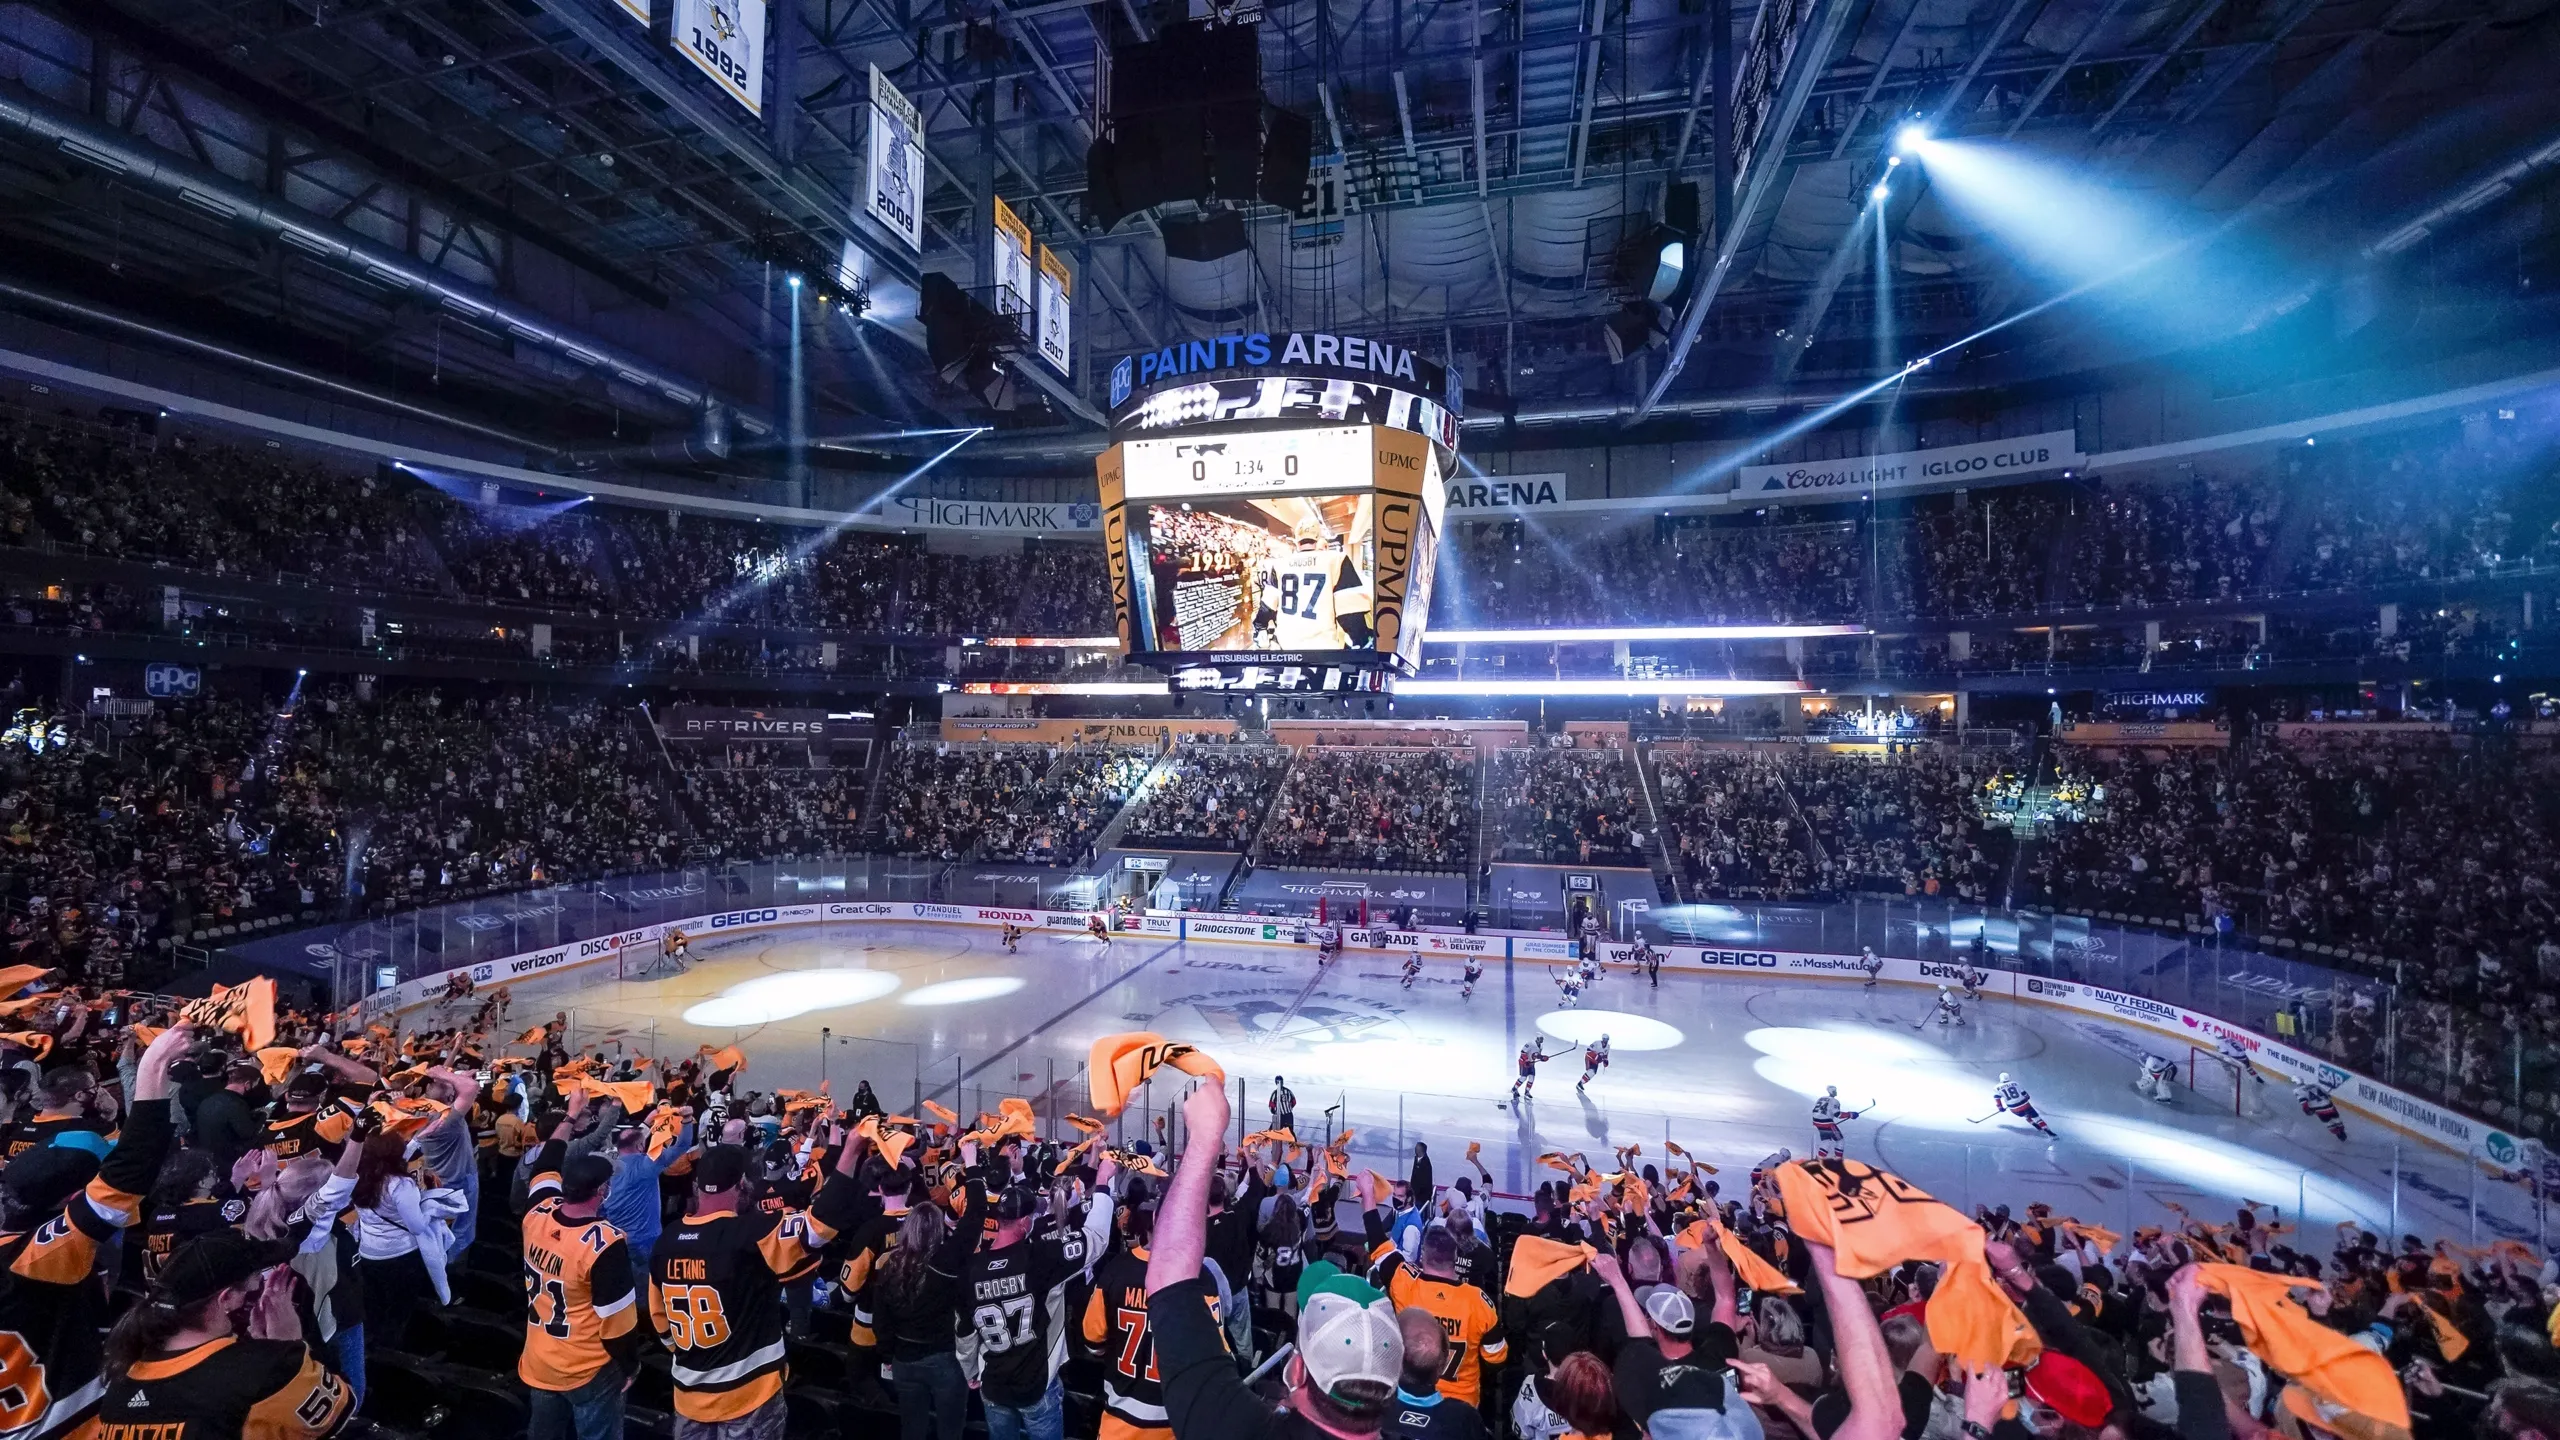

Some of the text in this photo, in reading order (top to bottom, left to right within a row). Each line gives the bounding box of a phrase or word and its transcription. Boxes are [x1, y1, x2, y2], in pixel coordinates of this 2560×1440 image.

[1237, 12, 1261, 25] 2006
[692, 27, 747, 91] 1992
[876, 190, 914, 235] 2009
[1044, 336, 1064, 362] 2017
[1140, 332, 1272, 385] PAINTS
[1280, 333, 1417, 382] ARENA
[1192, 455, 1298, 481] 0 1:34 0
[1378, 450, 1420, 471] UPMC
[1787, 448, 2050, 489] Coors LIGHT IGLOO CLUB
[1100, 466, 1121, 488] UPMC
[1445, 481, 1558, 509] ARENA
[894, 497, 1059, 530] HIGHMARK
[1190, 551, 1233, 572] 1991
[1108, 512, 1130, 643] UPMC
[1376, 503, 1411, 640] UPMC
[1281, 573, 1326, 620] 87
[1210, 654, 1303, 663] MITSUBISHI ELECTRIC
[358, 673, 376, 682] 119
[995, 722, 1029, 730] PLAYOFFS
[1138, 726, 1169, 737] CLUB
[1780, 735, 1830, 743] PENUINS
[630, 883, 702, 901] UPMC
[503, 902, 566, 921] PAINTS
[710, 908, 778, 929] GEICO
[830, 904, 893, 915] Great Clips
[926, 906, 963, 914] FANDUEL
[978, 910, 1034, 922] HONDA
[1046, 915, 1086, 927] guaranteed
[1146, 919, 1171, 927] TRULY
[1194, 922, 1256, 936] BRIDGESTONE
[581, 931, 643, 957] DISCOVER
[1350, 931, 1419, 945] GATORADE
[1449, 936, 1487, 946] Little Caesars
[511, 952, 564, 974] verizon
[1610, 949, 1666, 963] verizn
[1701, 950, 1777, 967] GEICO
[1804, 958, 1871, 972] MassMutua
[1184, 960, 1287, 974] UPMC
[1919, 962, 1989, 986] betwy
[2044, 981, 2075, 994] DOWNLOAD
[2044, 988, 2067, 998] THE APP
[2095, 990, 2177, 1018] NAVY FEDERAL
[2113, 1005, 2160, 1023] Credit Union
[2267, 1048, 2344, 1088] THE BEST RUN SAP
[2001, 1087, 2020, 1100] 18
[1812, 1101, 1830, 1115] 24
[2358, 1083, 2377, 1102] NEW
[2378, 1091, 2438, 1129] AMSTERDAM
[2439, 1113, 2470, 1141] VODKA
[264, 1138, 301, 1156] WAGNER
[983, 1217, 1000, 1231] SBY
[677, 1231, 699, 1242] Reebok
[528, 1244, 564, 1276] MALKIN
[667, 1258, 706, 1281] LETANG
[974, 1273, 1027, 1301] CROSBY
[1124, 1286, 1149, 1308] MAL
[661, 1283, 732, 1351] 58
[972, 1293, 1036, 1355] 87
[1442, 1341, 1467, 1383] 7
[127, 1400, 150, 1408] adidas
